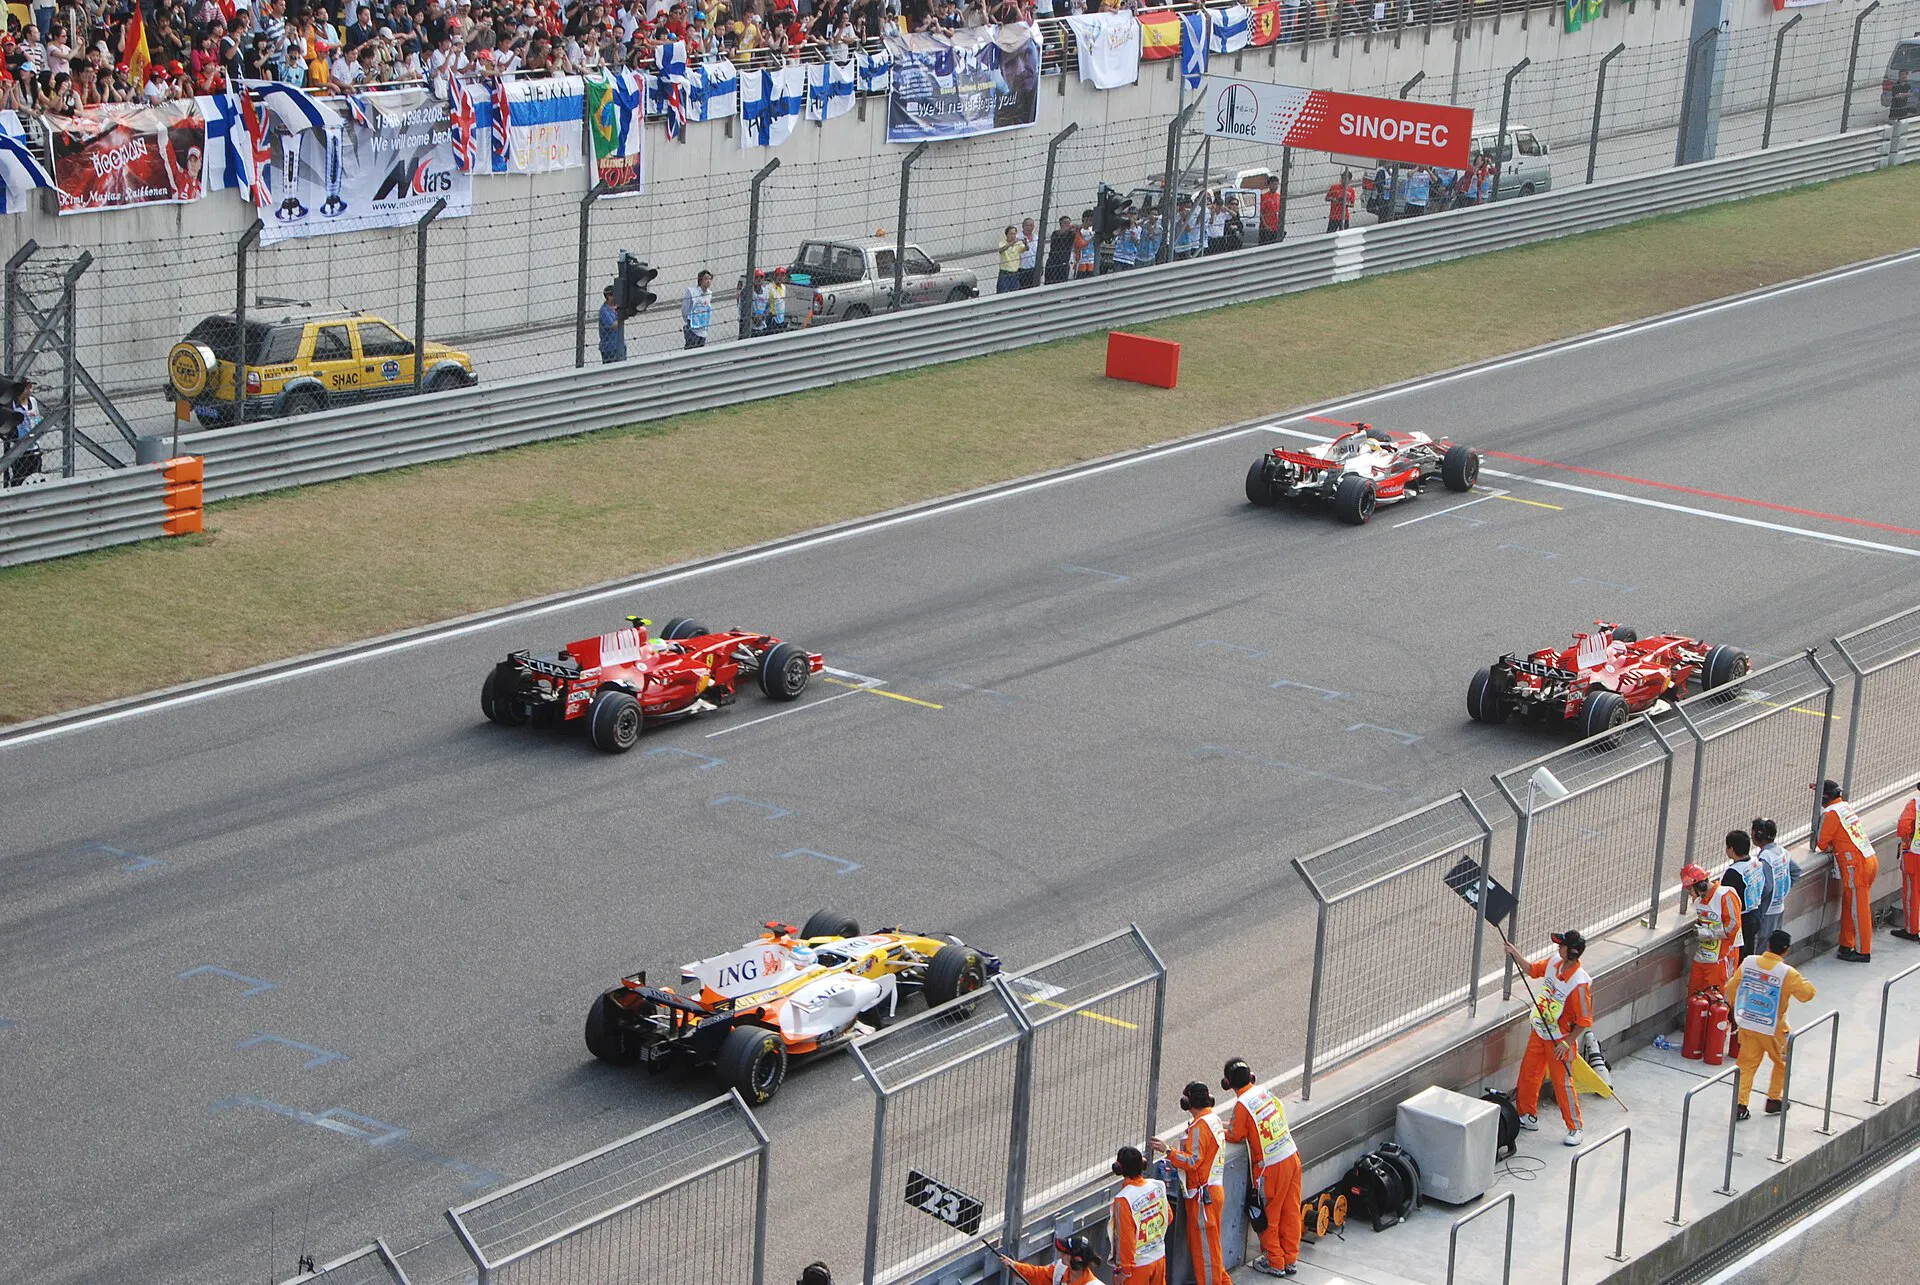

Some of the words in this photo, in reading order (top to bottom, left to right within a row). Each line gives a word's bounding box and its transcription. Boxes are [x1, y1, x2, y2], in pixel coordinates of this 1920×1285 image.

[370, 136, 389, 153] We
[391, 134, 406, 150] will
[406, 133, 430, 148] come
[432, 129, 452, 145] back
[1339, 113, 1449, 148] SINOPEC
[600, 158, 624, 168] KUNG
[827, 294, 837, 316] 2
[332, 373, 359, 387] SHAC
[717, 959, 758, 989] ING
[650, 989, 671, 1001] ING
[920, 1183, 960, 1222] 23
